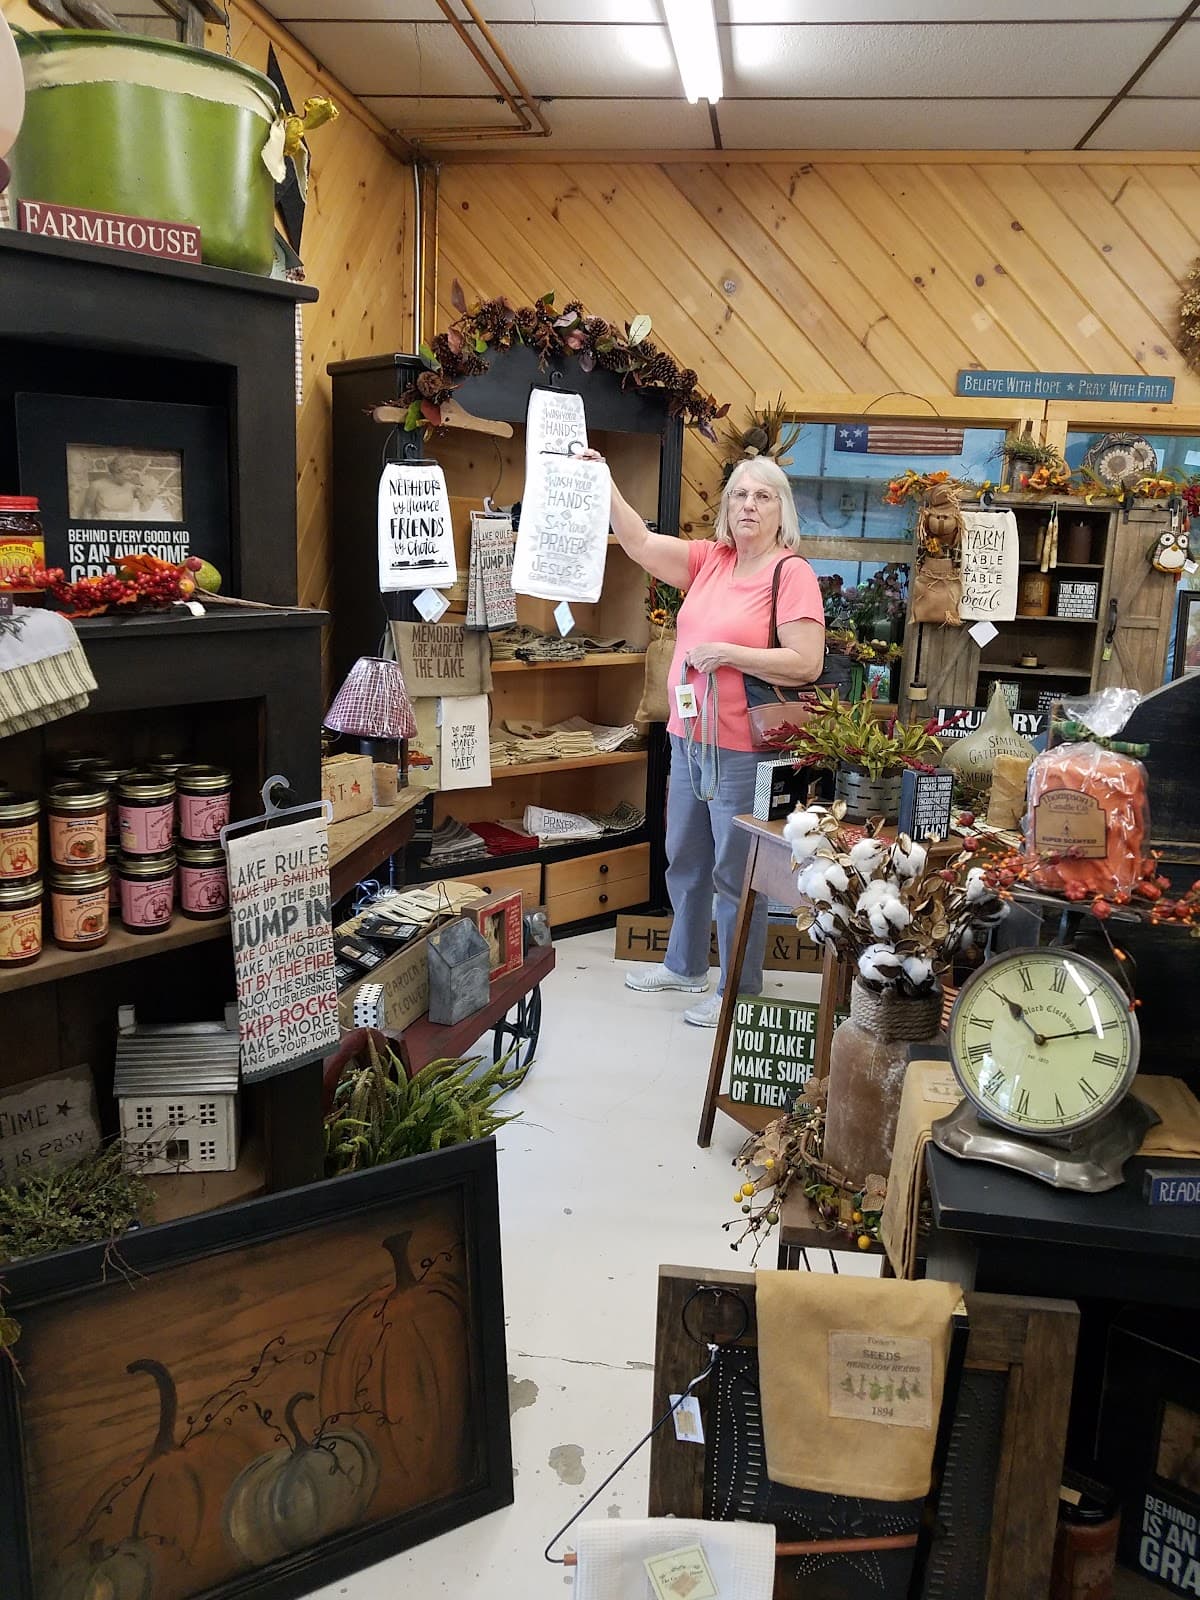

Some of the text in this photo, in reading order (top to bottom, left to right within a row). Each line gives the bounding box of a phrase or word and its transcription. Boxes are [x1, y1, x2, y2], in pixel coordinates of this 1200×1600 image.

[23, 202, 198, 257] FARMHOUSE
[964, 375, 1168, 398] BELIEVE WITH HOPE PRAY WITH FAITH
[545, 421, 578, 438] HANDS
[548, 476, 573, 490] WASH
[547, 490, 593, 511] HANDS
[68, 529, 190, 544] BEHIND EVERY GOOD KID
[390, 517, 444, 540] FRIENDS
[967, 530, 1005, 551] FARM
[69, 544, 84, 563] IS
[88, 544, 110, 564] AN
[965, 554, 1003, 565] TABLE
[963, 573, 1002, 584] TABLE
[412, 625, 465, 643] MEMORIES
[412, 643, 464, 658] ARE MADE AT
[413, 658, 465, 678] THE LAKE
[937, 708, 1043, 733] LAURY
[451, 755, 476, 768] HAPPY
[236, 859, 266, 887] AKE
[275, 843, 329, 874] RULES
[263, 878, 277, 892] UP
[263, 896, 277, 912] UP
[280, 888, 305, 906] THE
[233, 898, 331, 952] JUMP IN
[236, 925, 331, 964] AKE OUT THE BOA
[268, 937, 334, 968] MEMORIES
[772, 935, 790, 960] &
[256, 969, 273, 991] BY
[277, 959, 302, 982] THE
[304, 951, 334, 972] FIRE
[239, 967, 335, 1011] NJOY THE SUNSET
[239, 980, 336, 1021] OUNT YOUR BLESSINGS
[280, 991, 337, 1028] ROCKS
[737, 1003, 816, 1033] OF ALL THE
[278, 1010, 339, 1043] SMORES
[243, 1053, 266, 1067] ANG
[268, 1047, 280, 1059] UP
[280, 1037, 307, 1054] YOUR
[736, 1029, 815, 1060] YOU TAKE I
[733, 1055, 815, 1084] MAKE SURE
[732, 1081, 748, 1102] OF
[0, 1104, 49, 1139] TIME
[862, 1349, 901, 1361] SEEDS
[872, 1407, 894, 1417] 1894
[1145, 1494, 1196, 1531] BEHIND
[1142, 1510, 1198, 1558] IS AN
